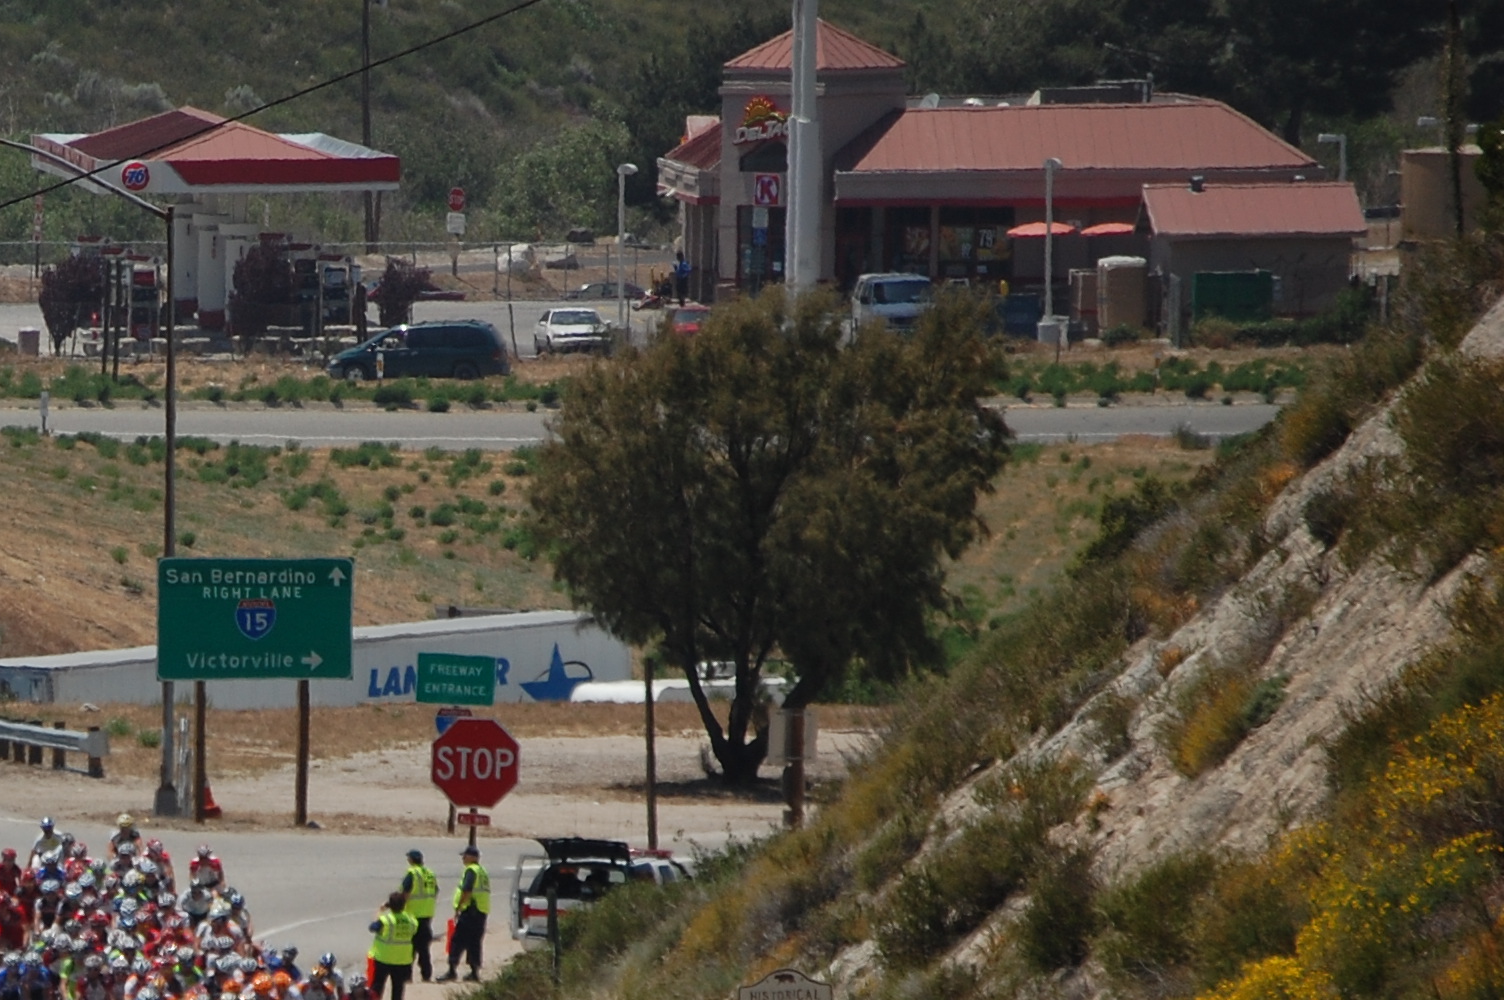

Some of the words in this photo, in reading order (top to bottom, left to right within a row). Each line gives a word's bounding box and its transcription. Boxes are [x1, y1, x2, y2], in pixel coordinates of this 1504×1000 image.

[126, 168, 146, 185] 76
[166, 569, 203, 584] San
[211, 569, 316, 585] Bernardino
[202, 587, 251, 599] RIGHT
[260, 587, 302, 598] LANE
[246, 613, 267, 631] 15
[187, 653, 294, 669] Victorville
[430, 664, 483, 676] FREEWAY
[425, 684, 486, 696] ENTRANCE
[437, 746, 514, 779] STOP
